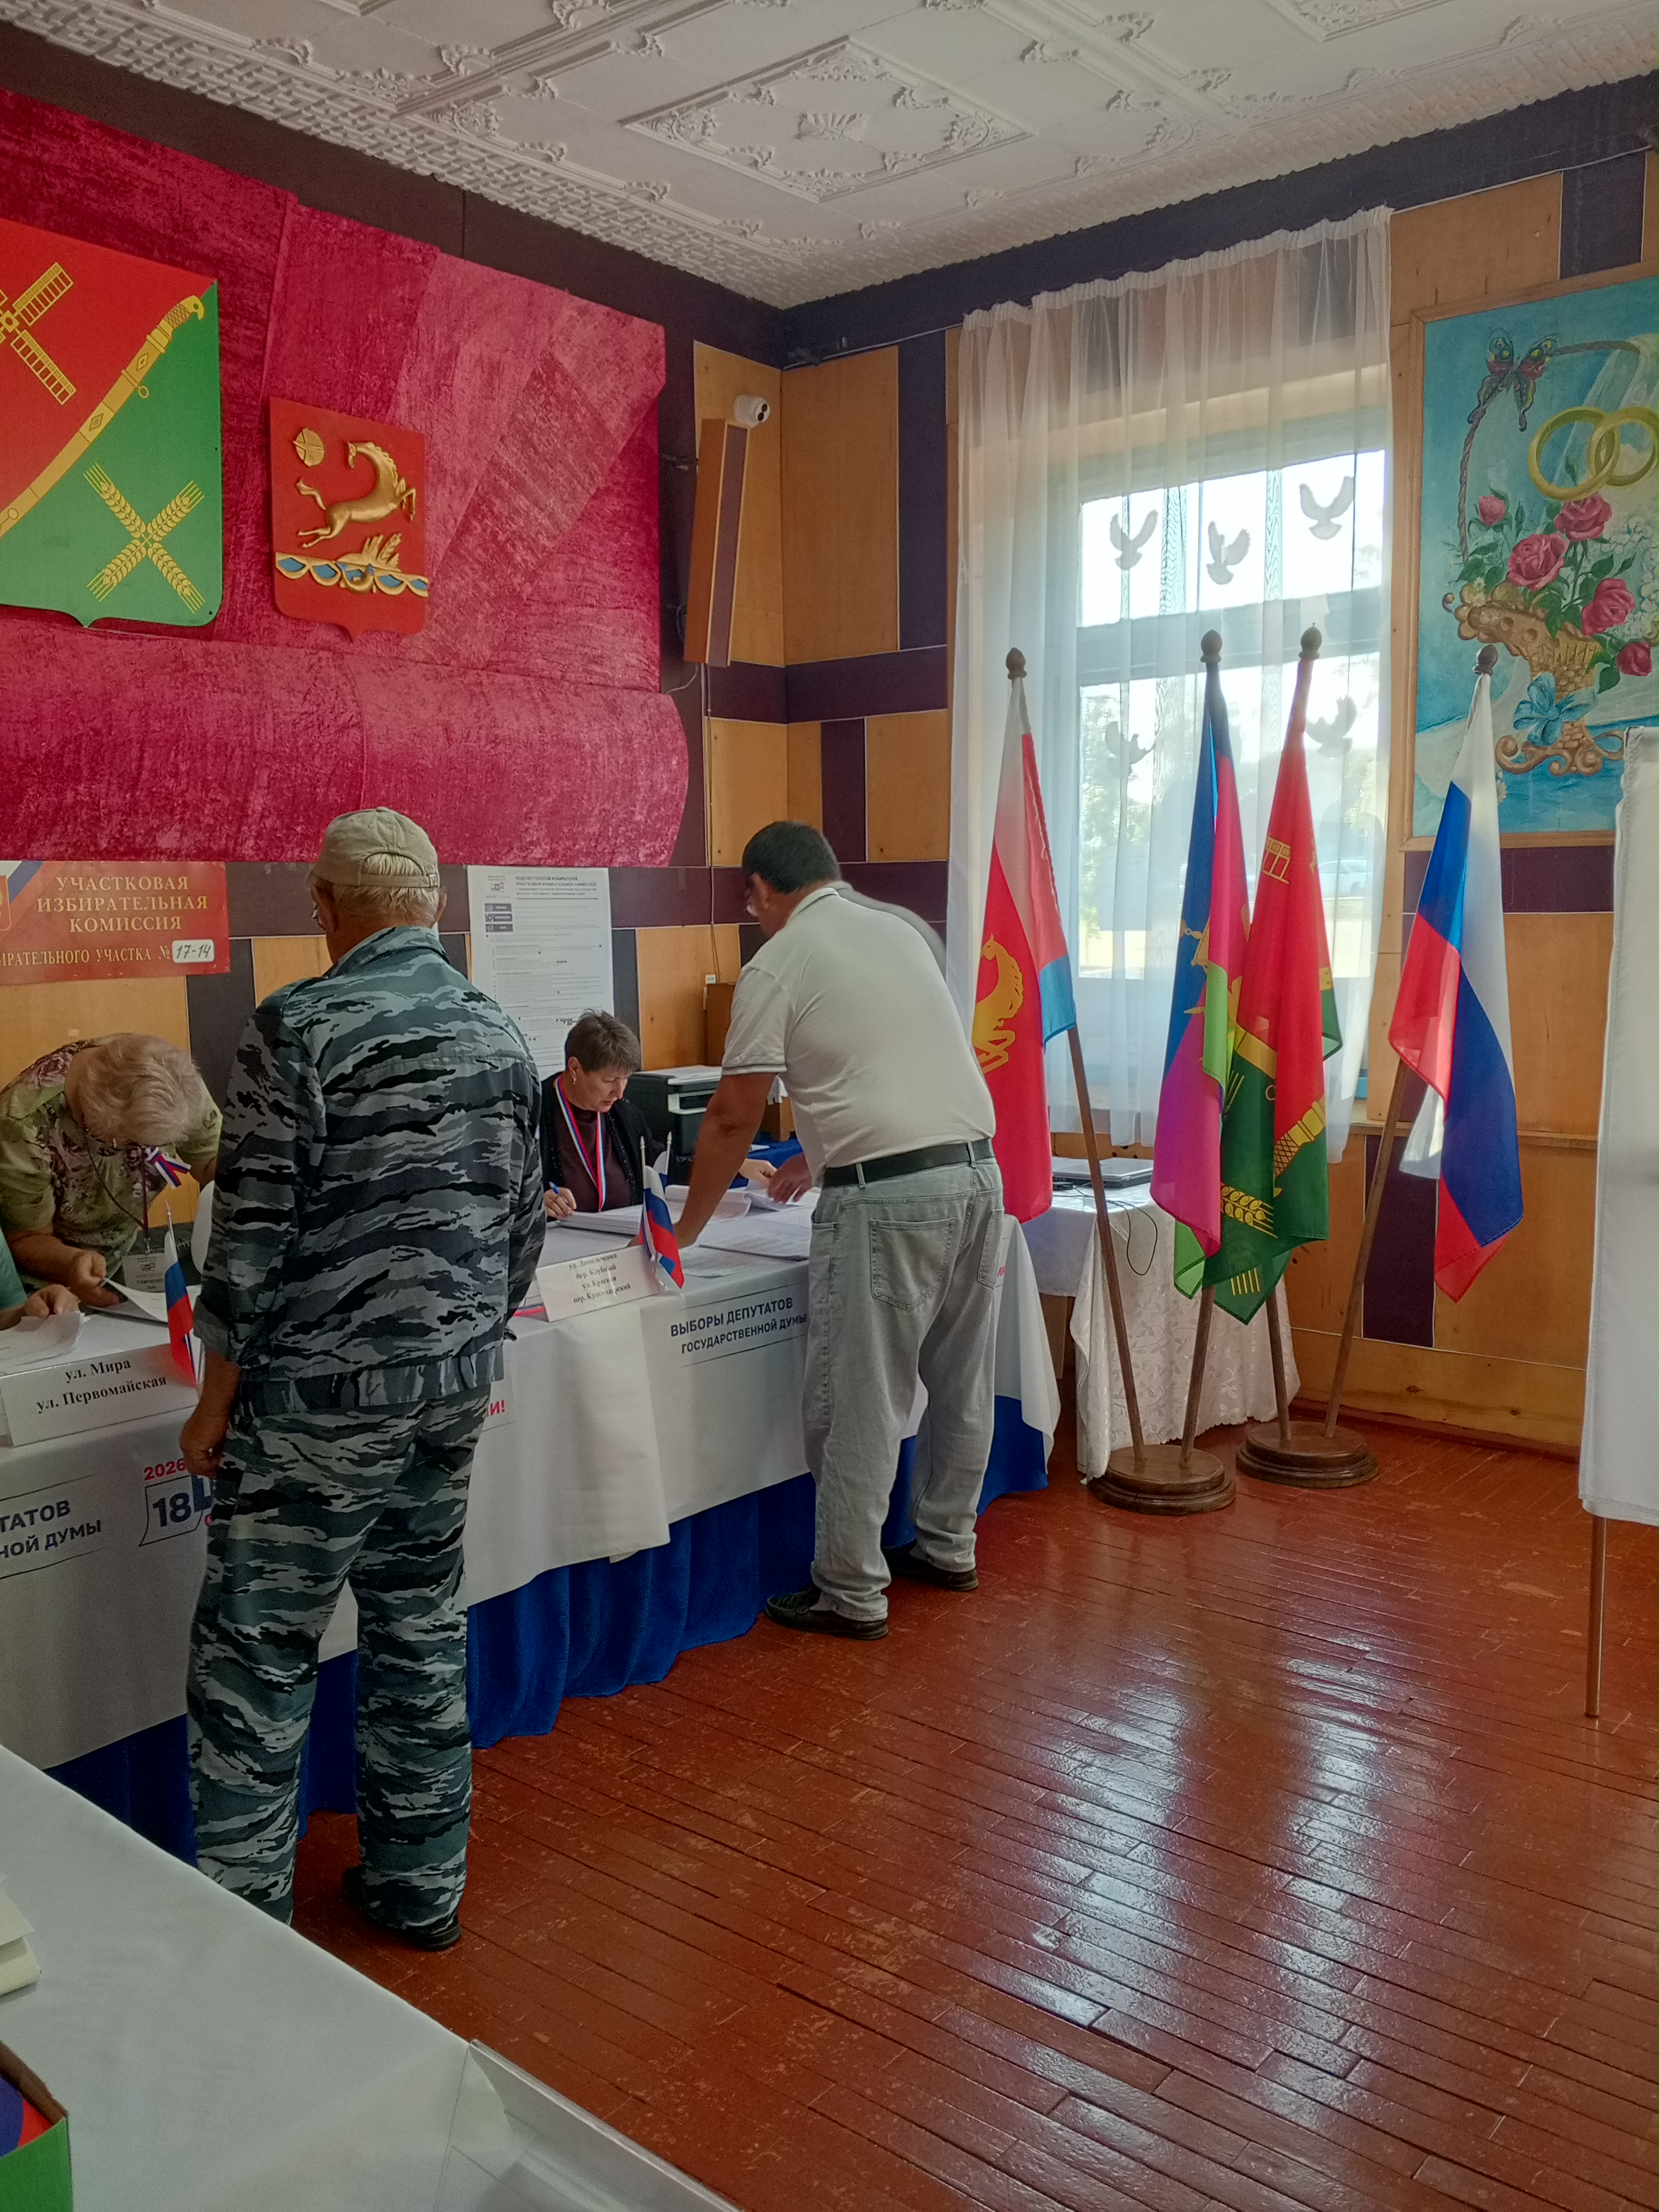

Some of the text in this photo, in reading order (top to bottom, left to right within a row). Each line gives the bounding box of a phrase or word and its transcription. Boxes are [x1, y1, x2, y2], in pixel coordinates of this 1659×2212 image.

[56, 876, 189, 892] УЧАСТКОВАЯ
[36, 895, 208, 912] ИЗБИРАТЕЛЬНАЯ
[69, 916, 182, 933] КОМИССИЯ
[96, 947, 151, 962] УЧАСТКА
[158, 945, 170, 960] №
[176, 944, 212, 959] 17-14
[573, 1296, 586, 1304] пер.
[671, 1297, 793, 1337] ВЫБОРЫ ДЕПУТАТОВ
[681, 1313, 807, 1354] ГОСУДАРСТВЕННОЙ ДУМЫ
[65, 1359, 132, 1384] ул. Мира
[36, 1375, 167, 1414] ул. Первомайская
[144, 1458, 187, 1481] 2026
[152, 1492, 192, 1527] 18
[45, 1519, 102, 1551] ДУМЫ
